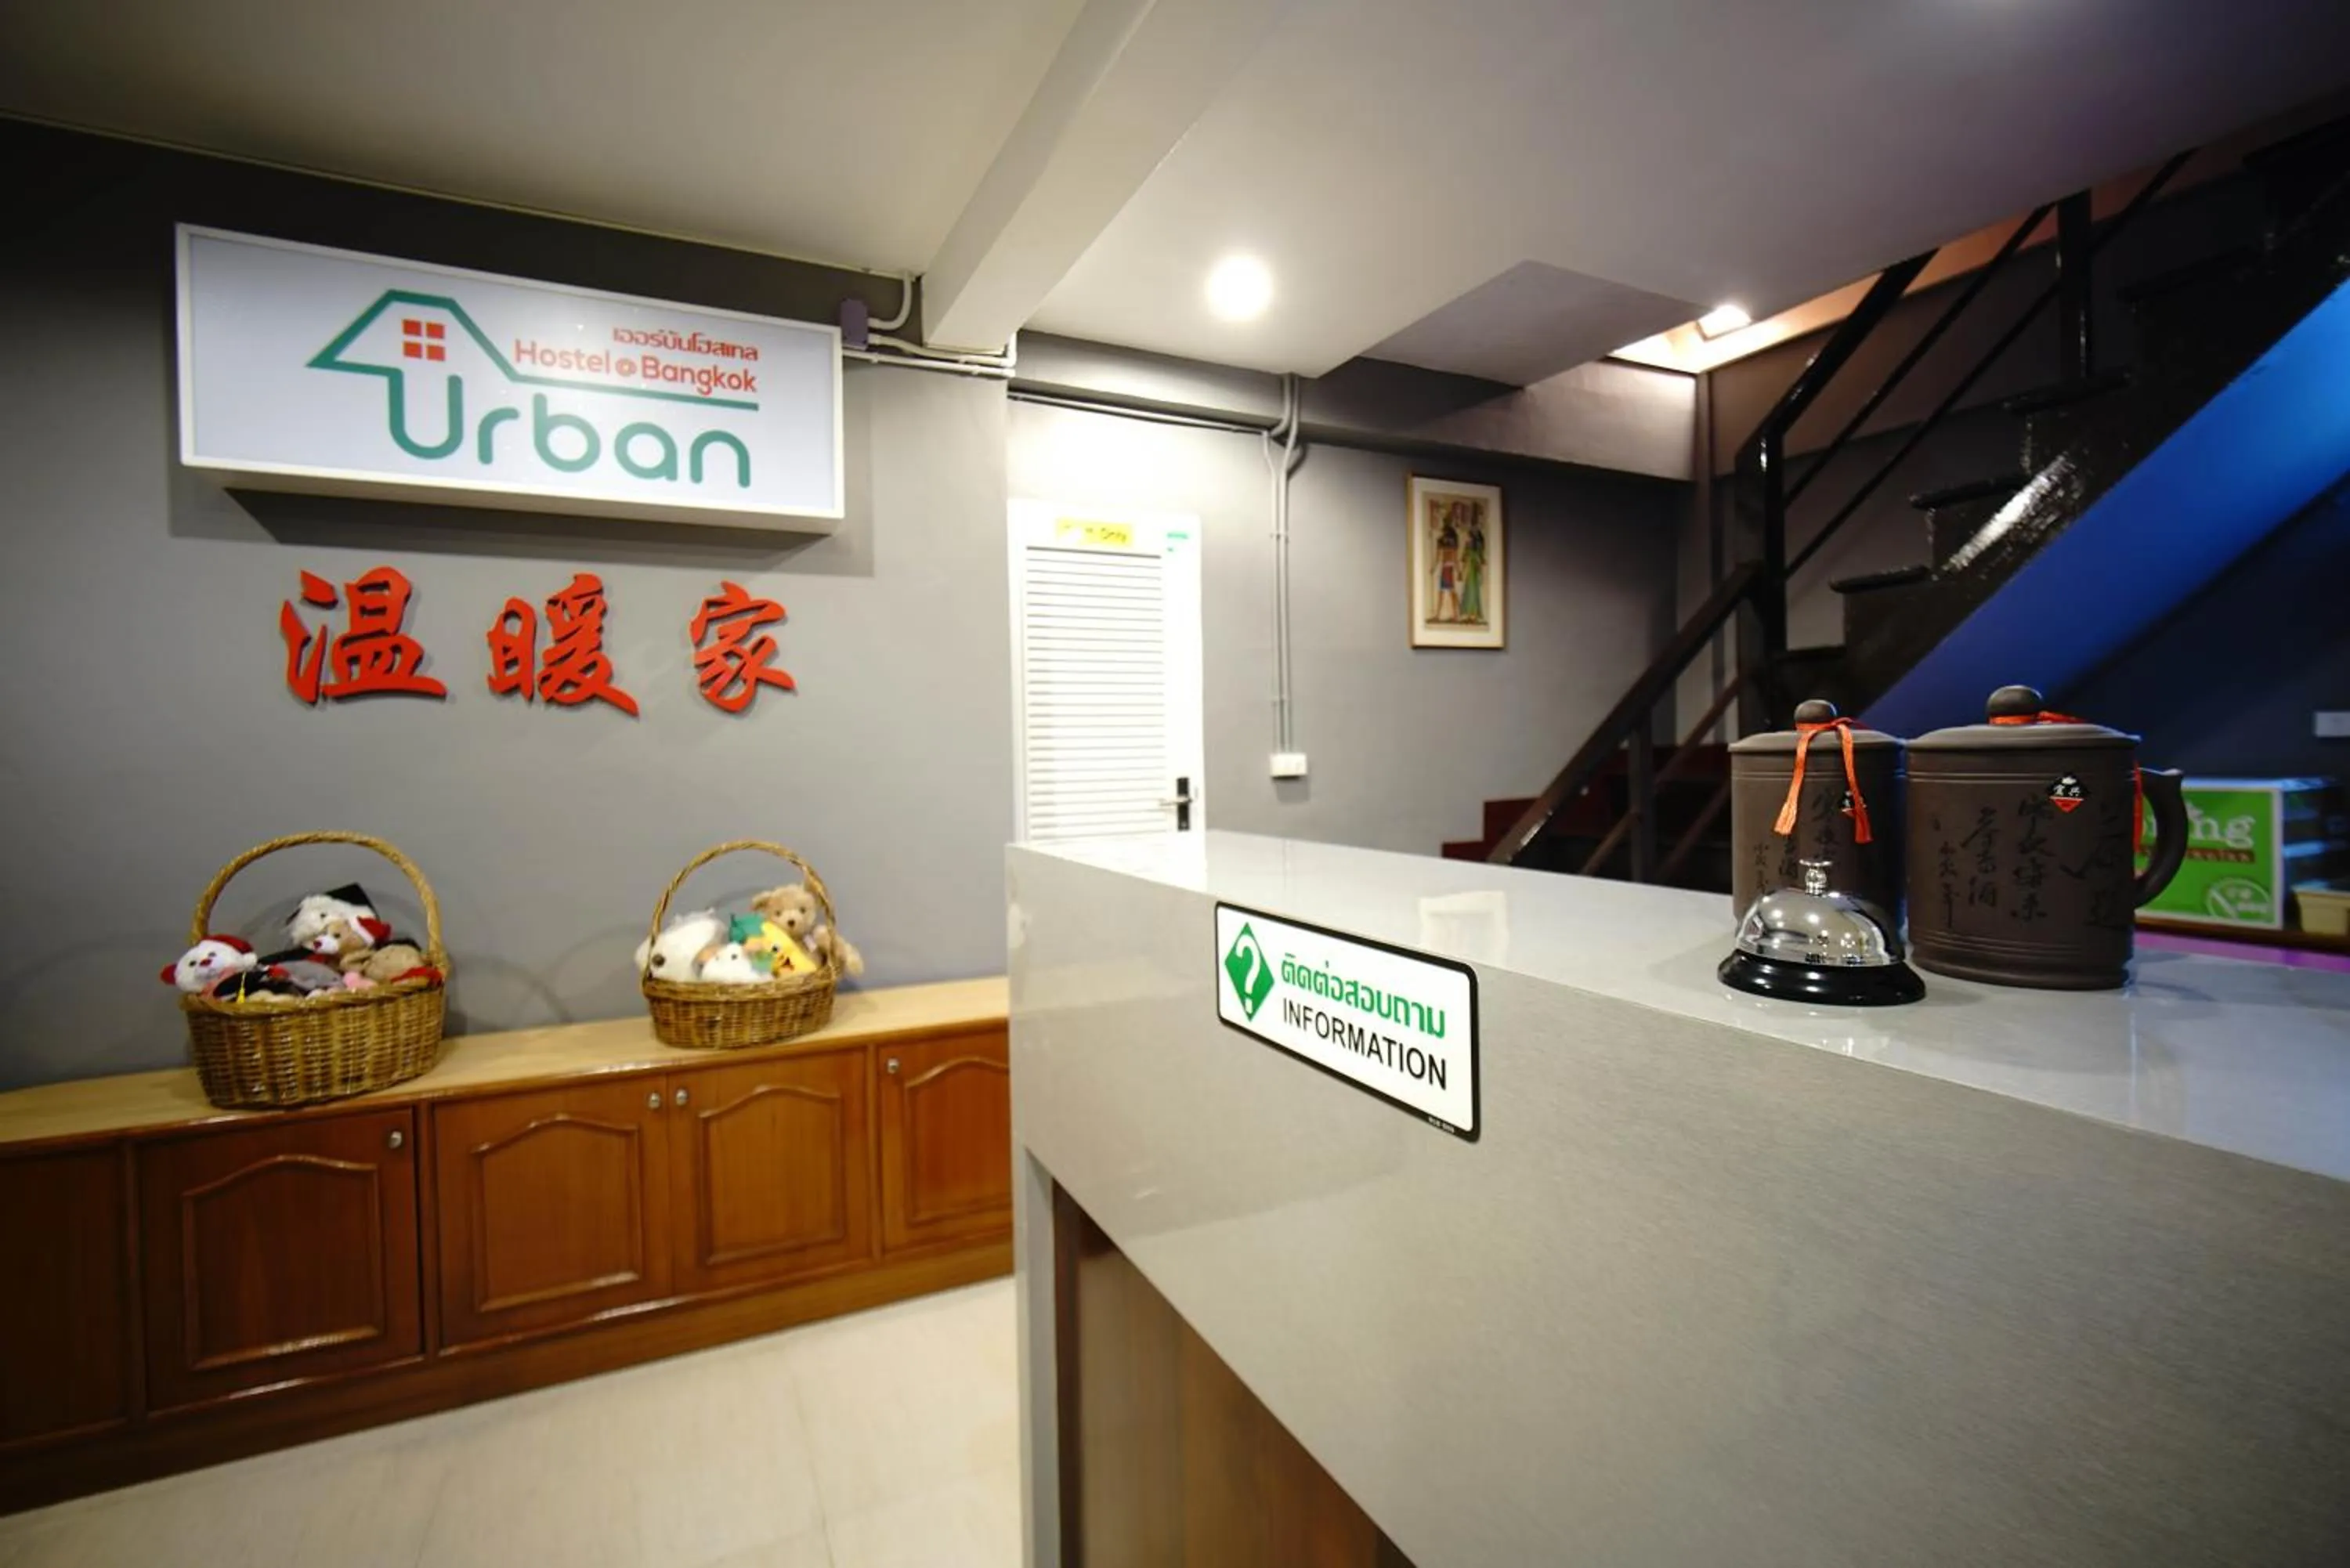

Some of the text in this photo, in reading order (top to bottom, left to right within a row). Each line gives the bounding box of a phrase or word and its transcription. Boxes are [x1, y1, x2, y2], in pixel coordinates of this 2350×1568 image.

[514, 338, 611, 374] Hostel
[641, 354, 758, 396] Bangkok
[388, 373, 751, 489] Urban
[1281, 952, 1446, 1039] ติดต่อสอบถาม
[1282, 997, 1448, 1091] INFORMATION
